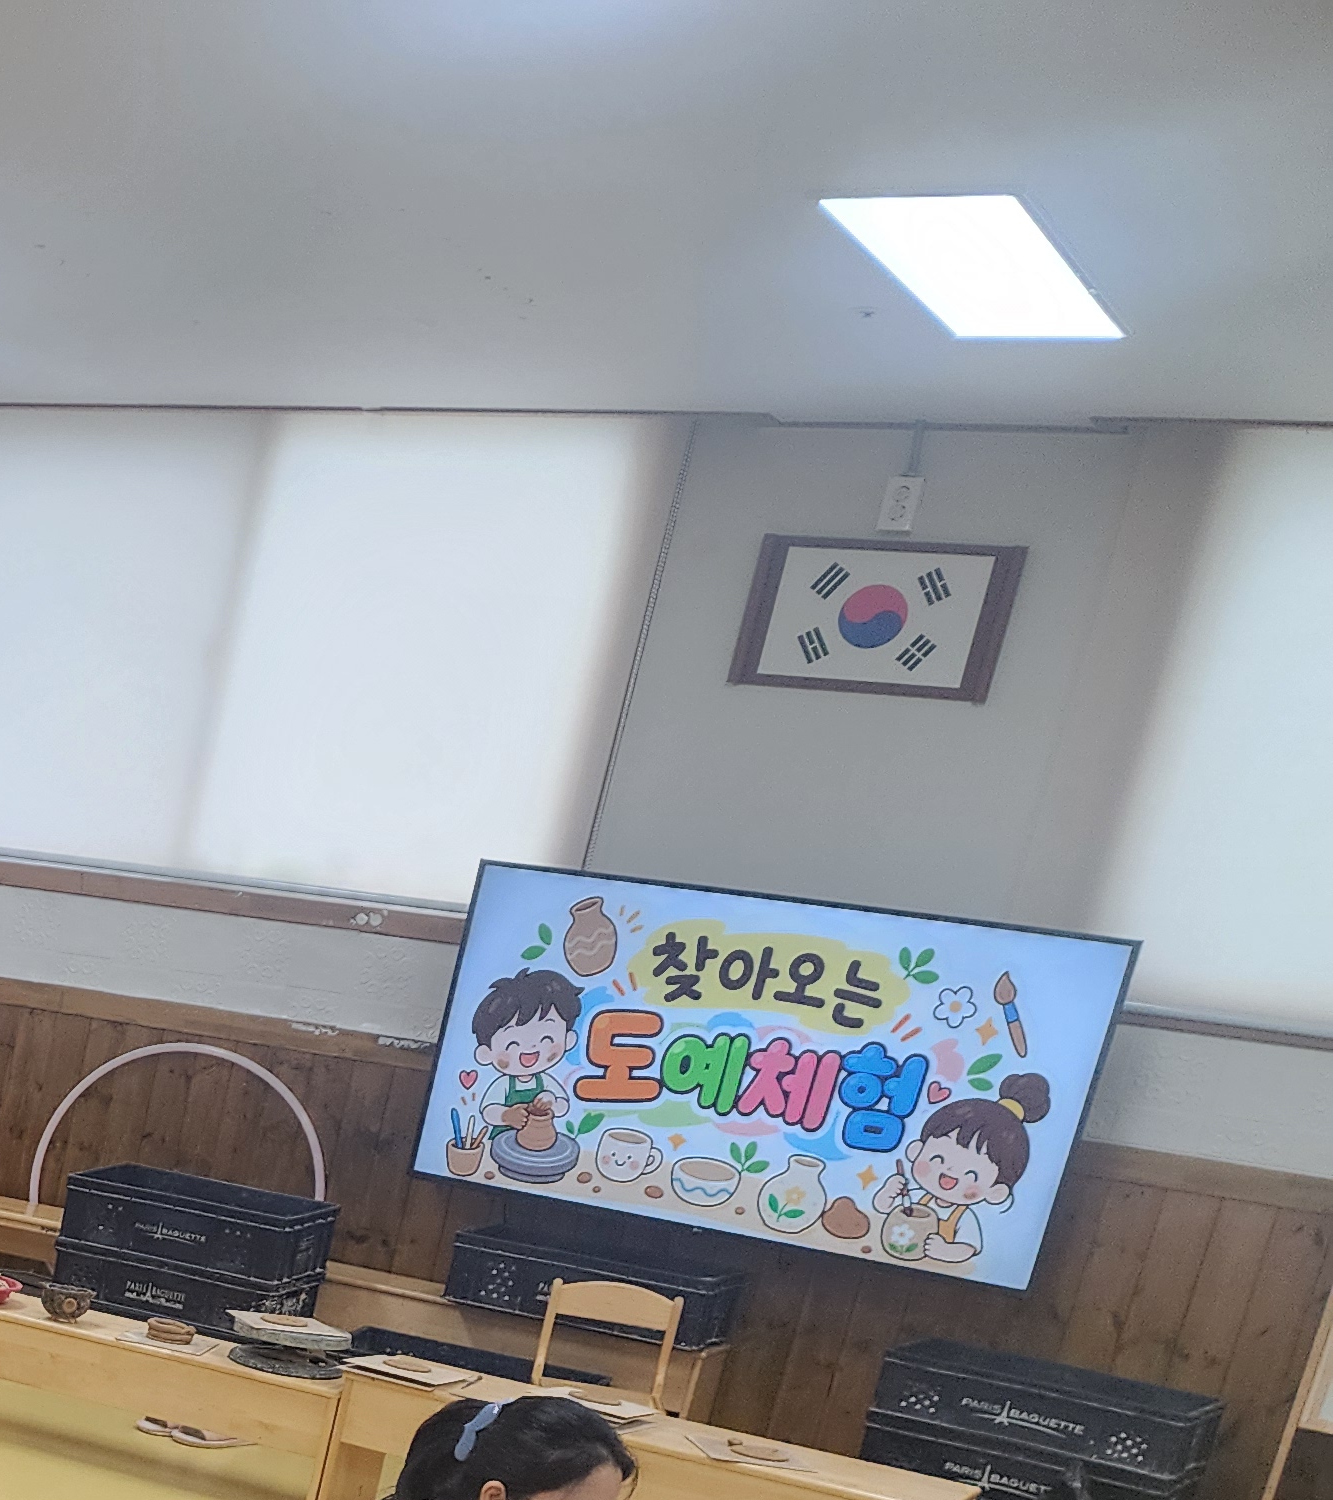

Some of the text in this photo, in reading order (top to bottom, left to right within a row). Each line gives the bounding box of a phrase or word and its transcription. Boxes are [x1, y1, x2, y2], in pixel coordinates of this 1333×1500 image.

[652, 931, 882, 1028] 찾아오는
[574, 1008, 929, 1152] 도예체험
[961, 1397, 1085, 1435] PARIS BAGUETTE
[944, 1461, 983, 1479] PARIS
